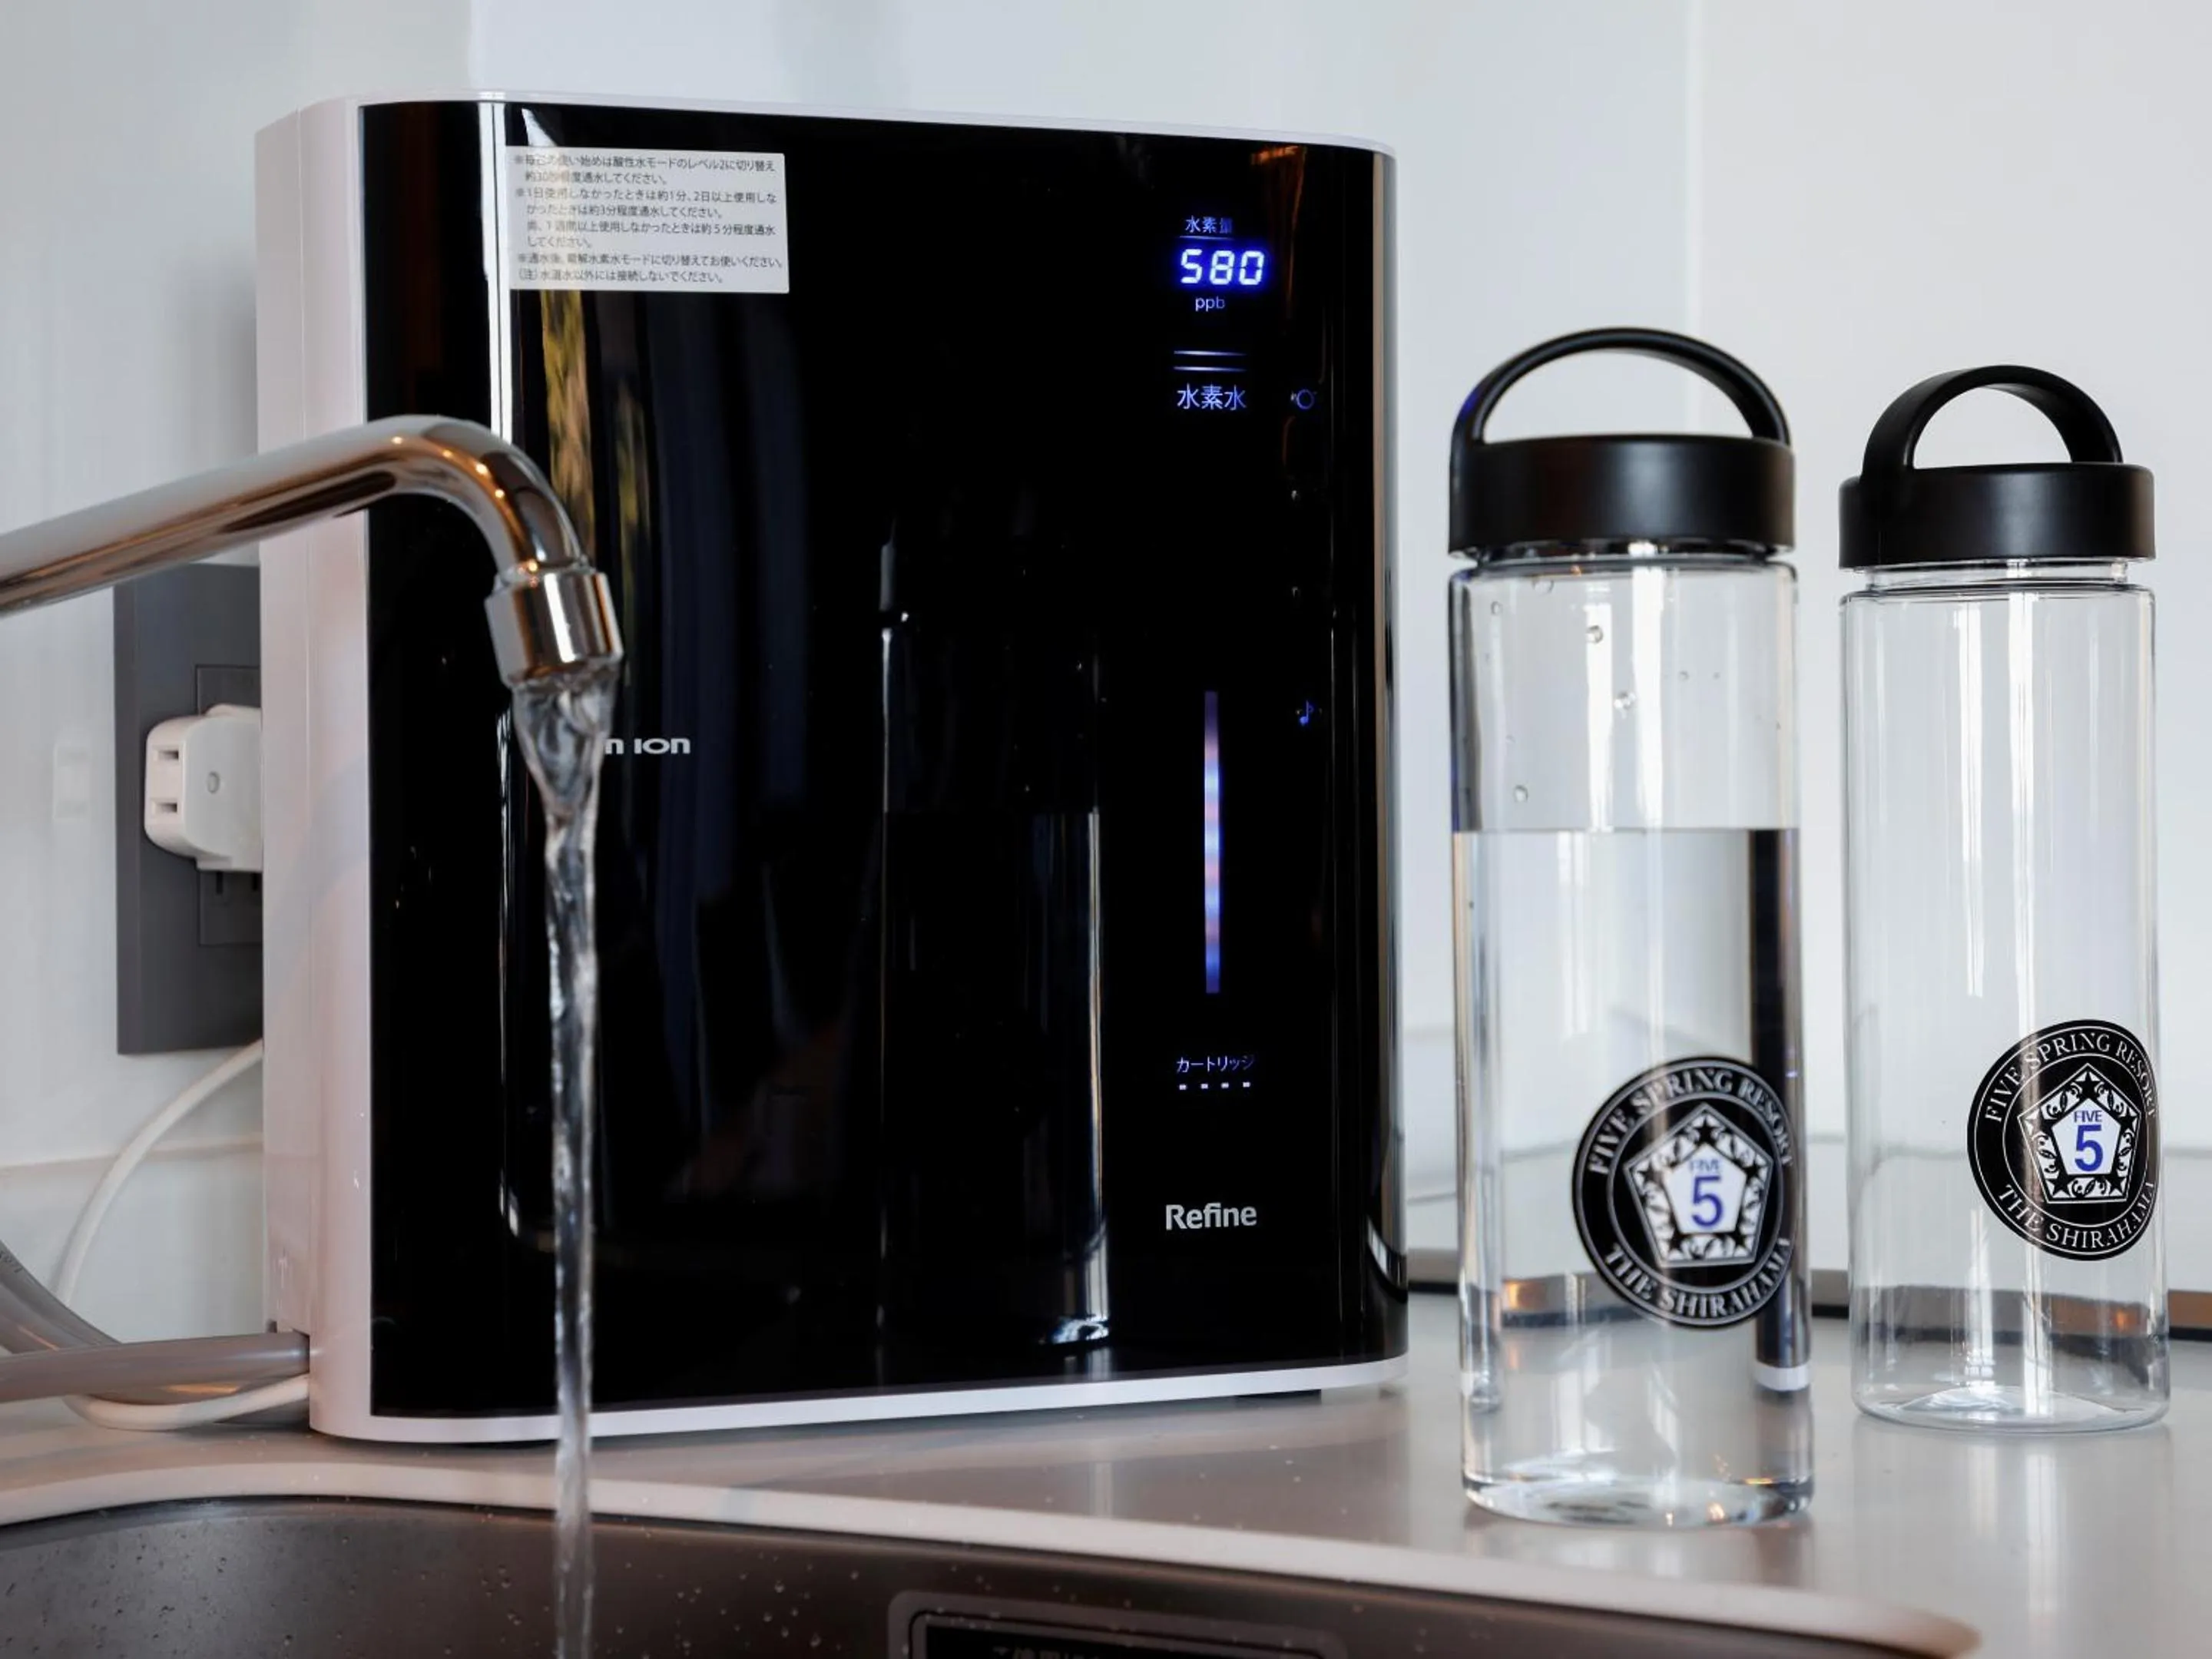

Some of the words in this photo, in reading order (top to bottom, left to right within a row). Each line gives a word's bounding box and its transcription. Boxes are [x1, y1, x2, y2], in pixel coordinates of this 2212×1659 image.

[1180, 248, 1266, 285] 580
[1195, 296, 1227, 313] ppb
[1176, 382, 1247, 411] 水素水
[1176, 1055, 1255, 1074] カートリッジ
[1984, 1066, 2025, 1123] FIVE
[2025, 1031, 2111, 1070] SPRING
[1587, 1108, 1634, 1176] FIVE
[1632, 1068, 1734, 1114] SPRING
[2074, 1110, 2103, 1124] FIVE
[2074, 1124, 2104, 1172] 5
[1165, 1202, 1258, 1230] Refine
[1691, 1175, 1724, 1228] 5
[1998, 1184, 2045, 1232] THE
[1604, 1242, 1657, 1300] THE
